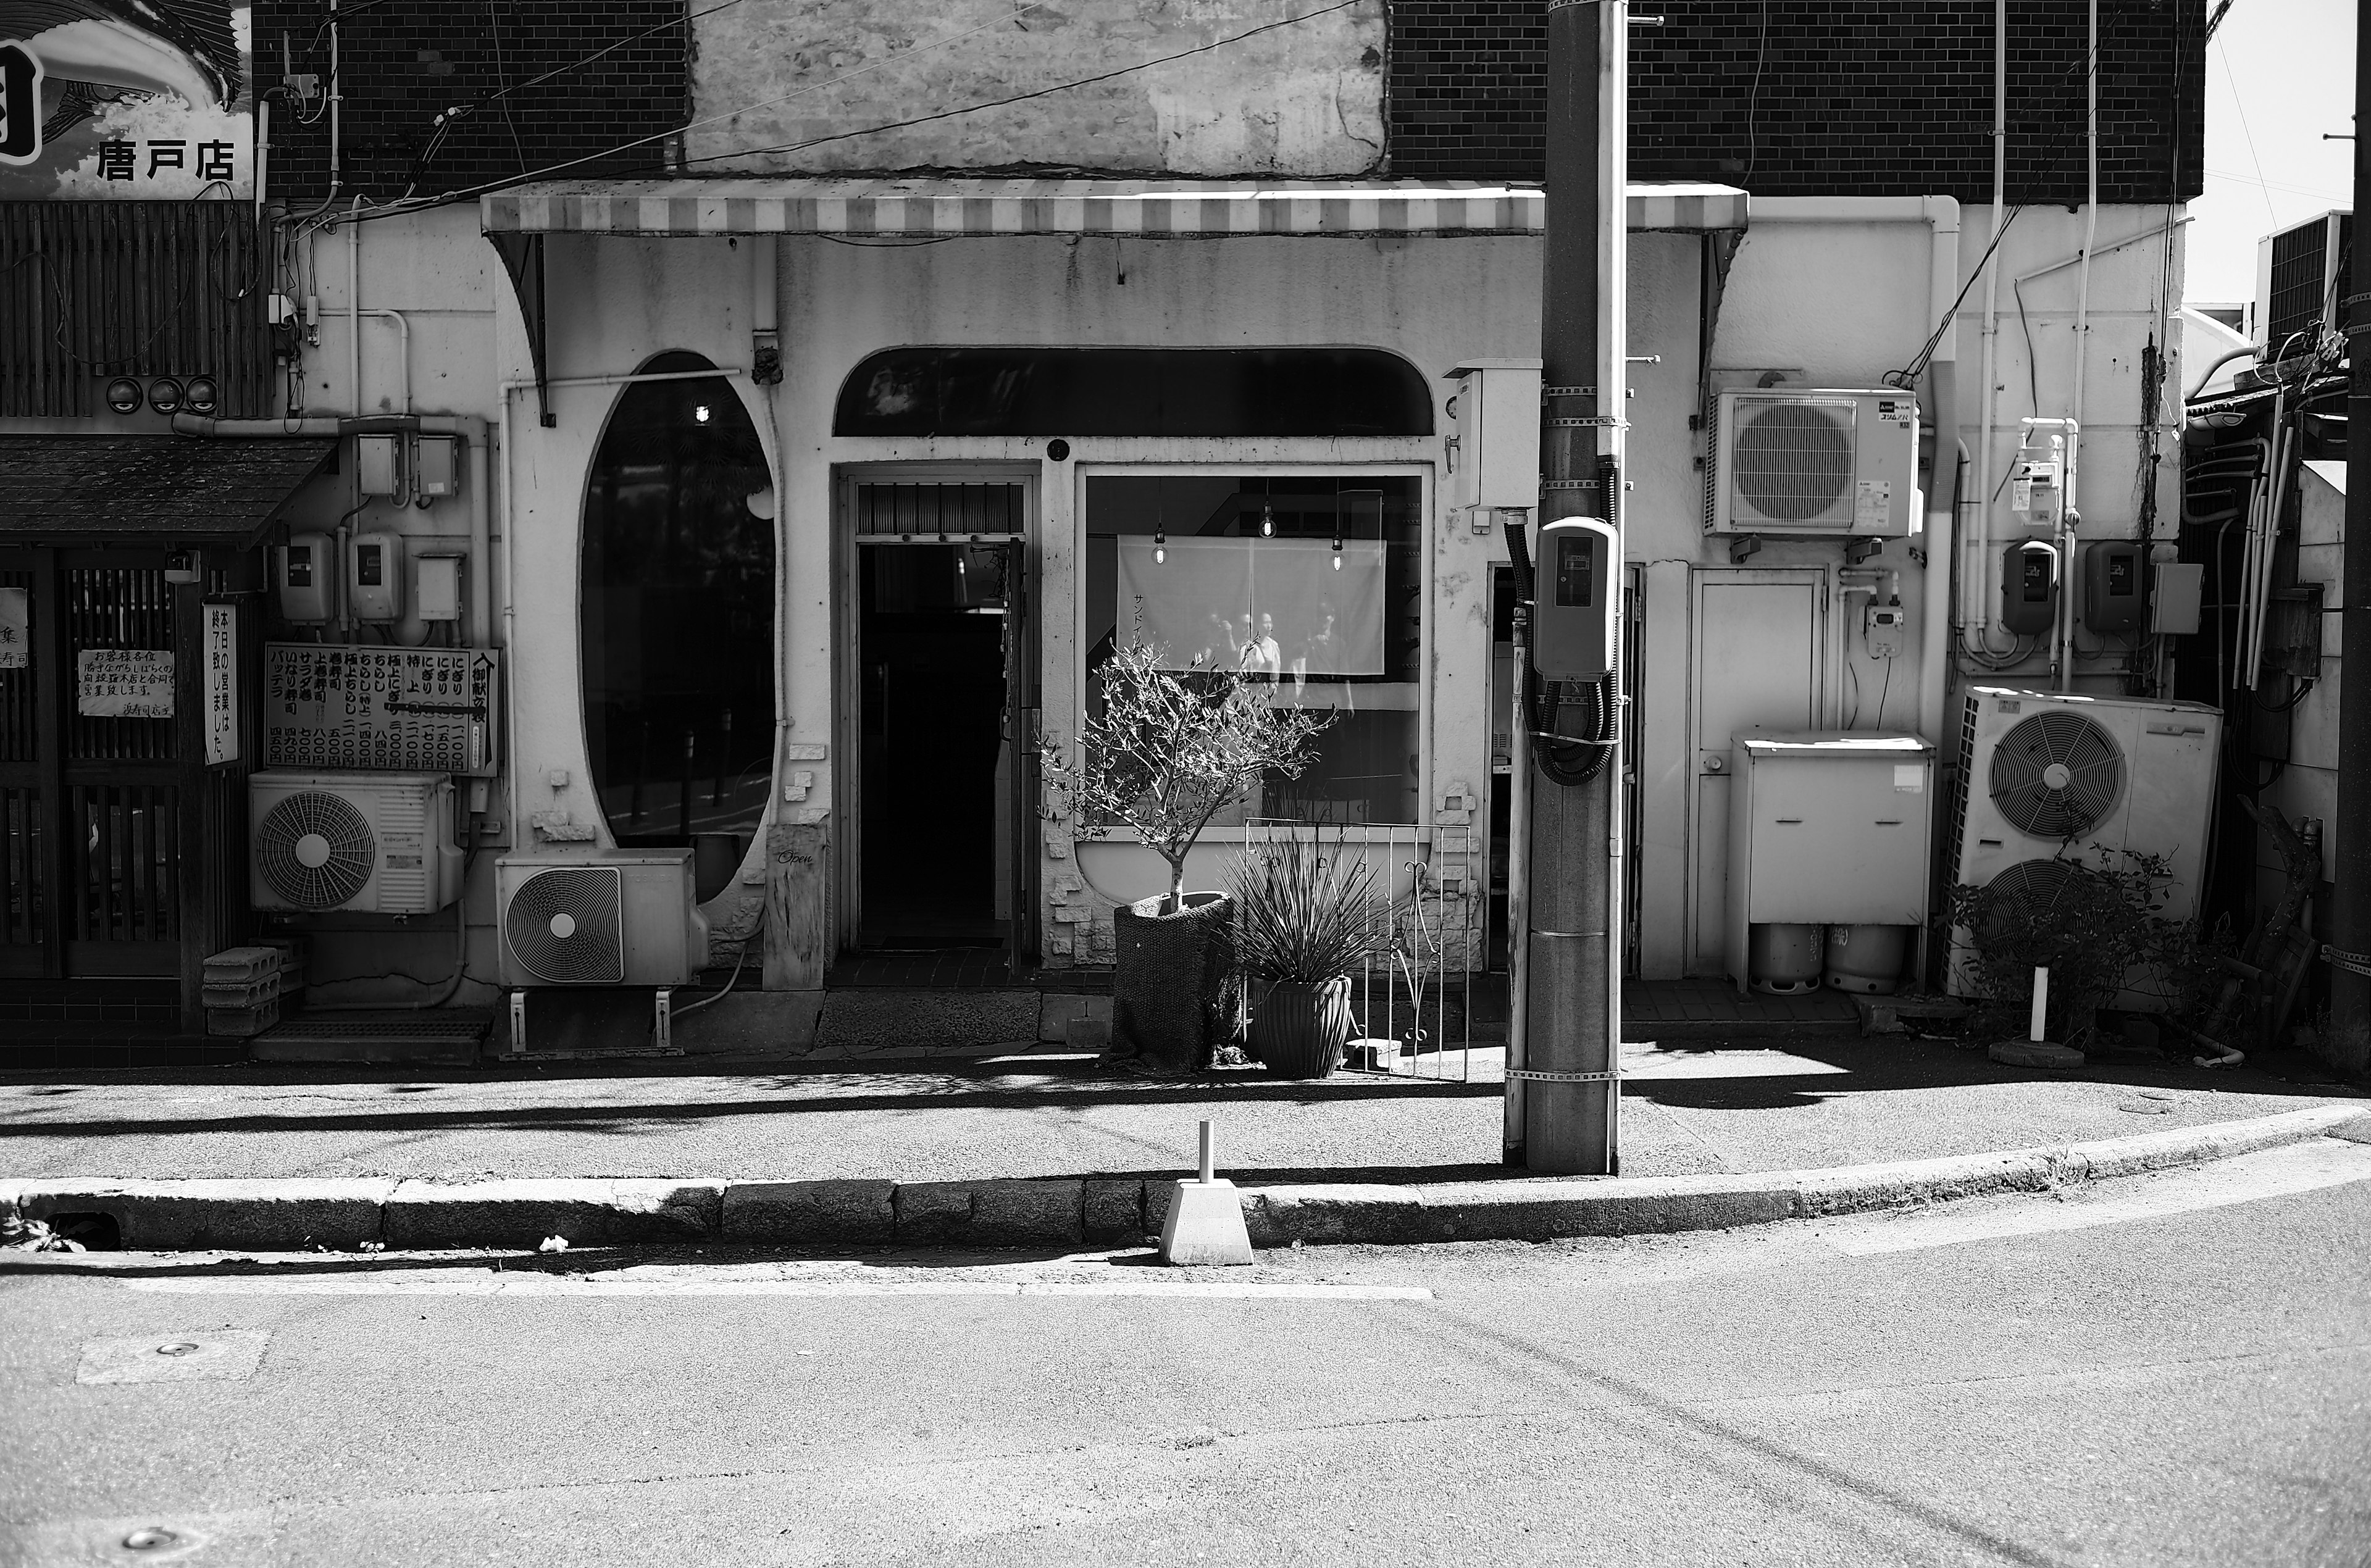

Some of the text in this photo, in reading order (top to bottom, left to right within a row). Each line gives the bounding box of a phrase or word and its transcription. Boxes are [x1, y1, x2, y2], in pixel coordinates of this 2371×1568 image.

[96, 139, 234, 181] 唐戸店
[0, 652, 28, 666] 寿司
[84, 661, 172, 673] 勝手ながらしばらくの
[95, 651, 156, 662] お客様各位
[221, 610, 230, 732] 本日の営業は
[270, 651, 284, 698] バッテラ
[375, 654, 385, 692] ちらし
[422, 656, 435, 694] にぎり
[437, 657, 450, 694] にぎり
[85, 685, 150, 696] 営業致します。
[212, 609, 224, 760] 終了致しました。
[285, 652, 298, 715] いなり寿司
[299, 652, 312, 701] サラダ巻
[344, 652, 358, 715] 極上ちらし
[452, 657, 464, 695] にぎり
[778, 850, 813, 865] Open
